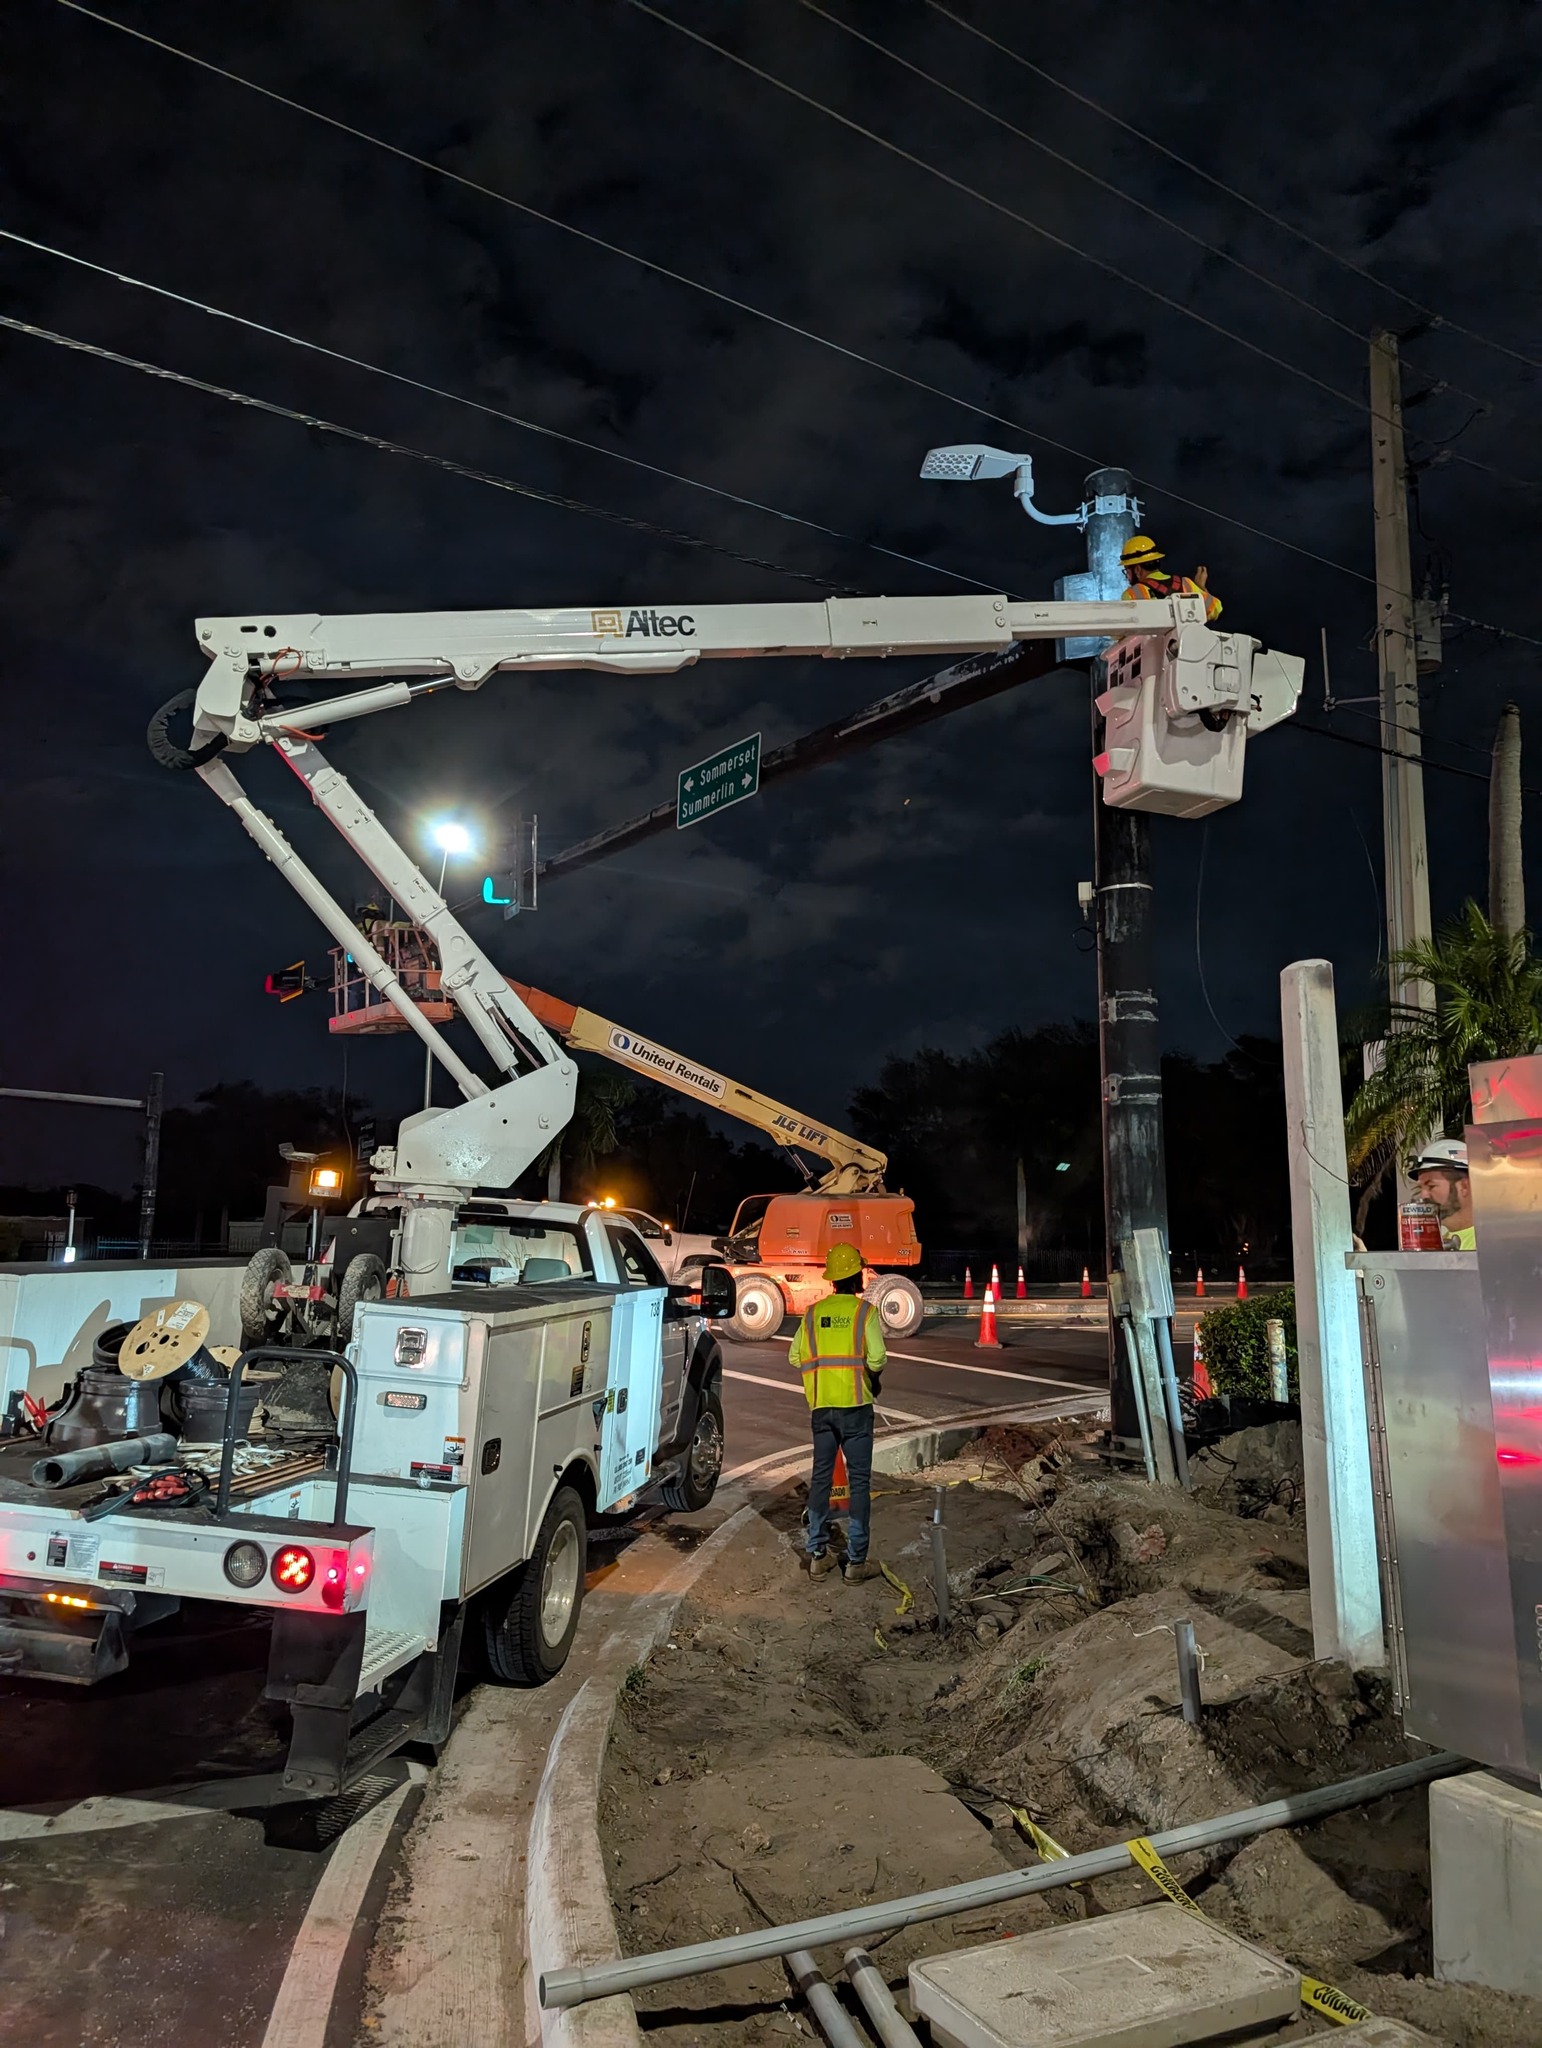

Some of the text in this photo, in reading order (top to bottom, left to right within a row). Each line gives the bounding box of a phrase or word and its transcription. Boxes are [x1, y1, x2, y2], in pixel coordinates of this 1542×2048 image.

[625, 610, 696, 637] Altec
[700, 744, 756, 786] Sommerset
[682, 782, 735, 818] Summerlin
[631, 1042, 720, 1093] United Rentals
[772, 1115, 828, 1145] JLG LIFT
